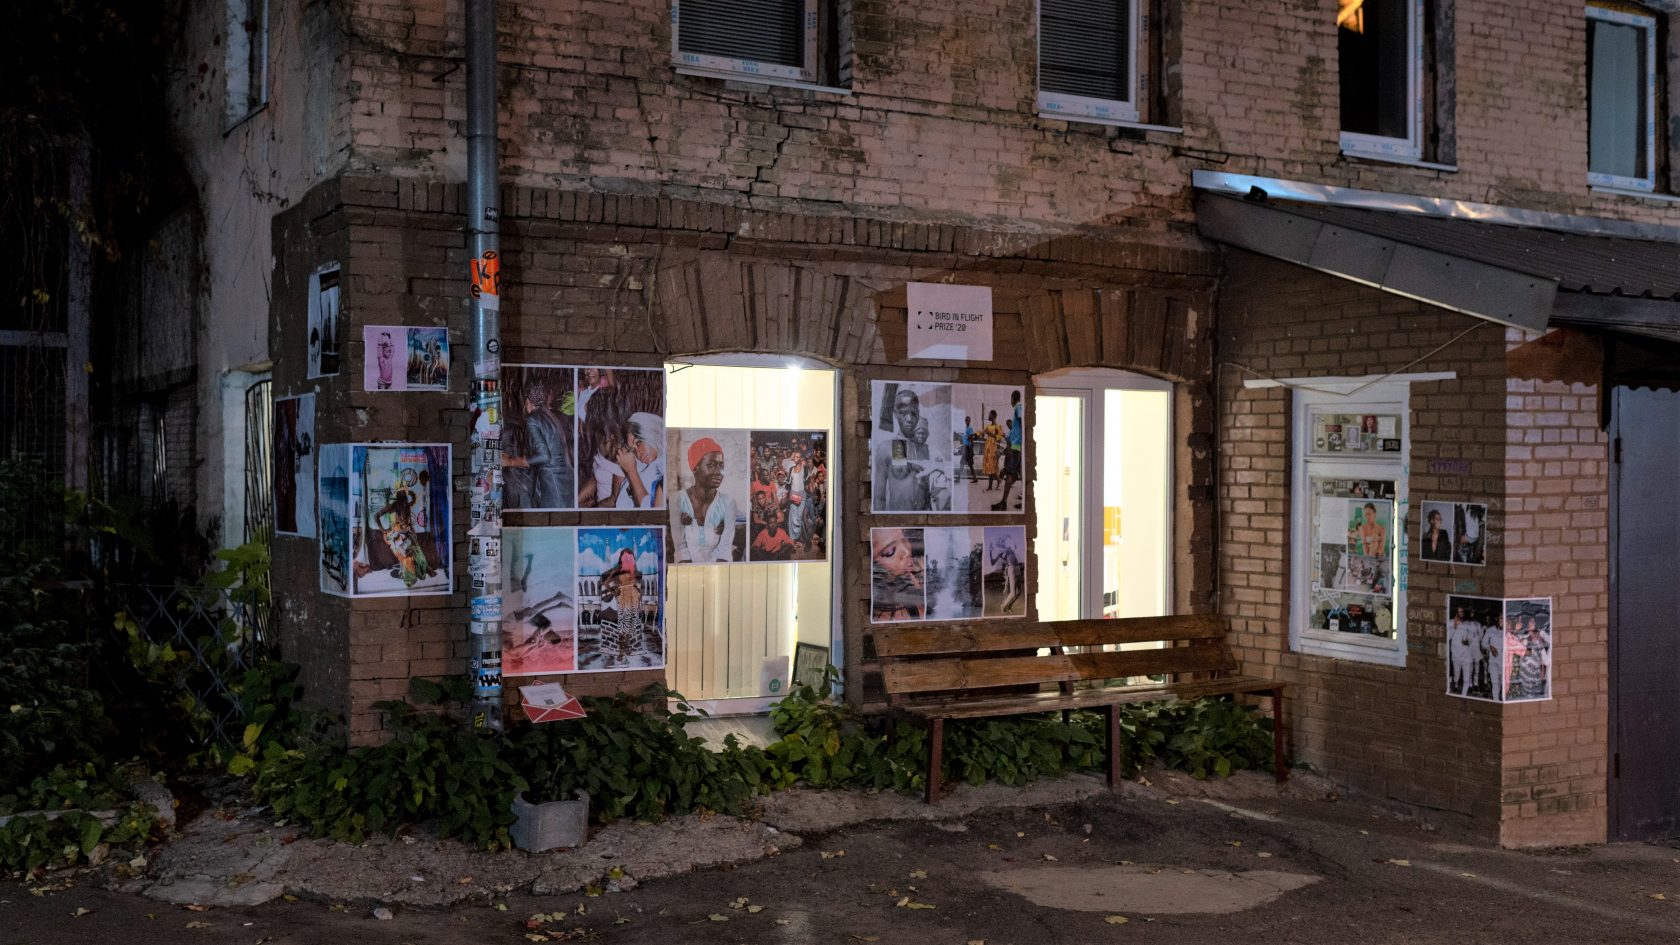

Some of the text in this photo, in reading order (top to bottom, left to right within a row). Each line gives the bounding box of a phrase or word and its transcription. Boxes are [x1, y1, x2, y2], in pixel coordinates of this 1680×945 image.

[682, 54, 700, 62] VEKA
[935, 311, 984, 322] BIRD IN FLIGHT
[934, 322, 954, 331] PRIZE
